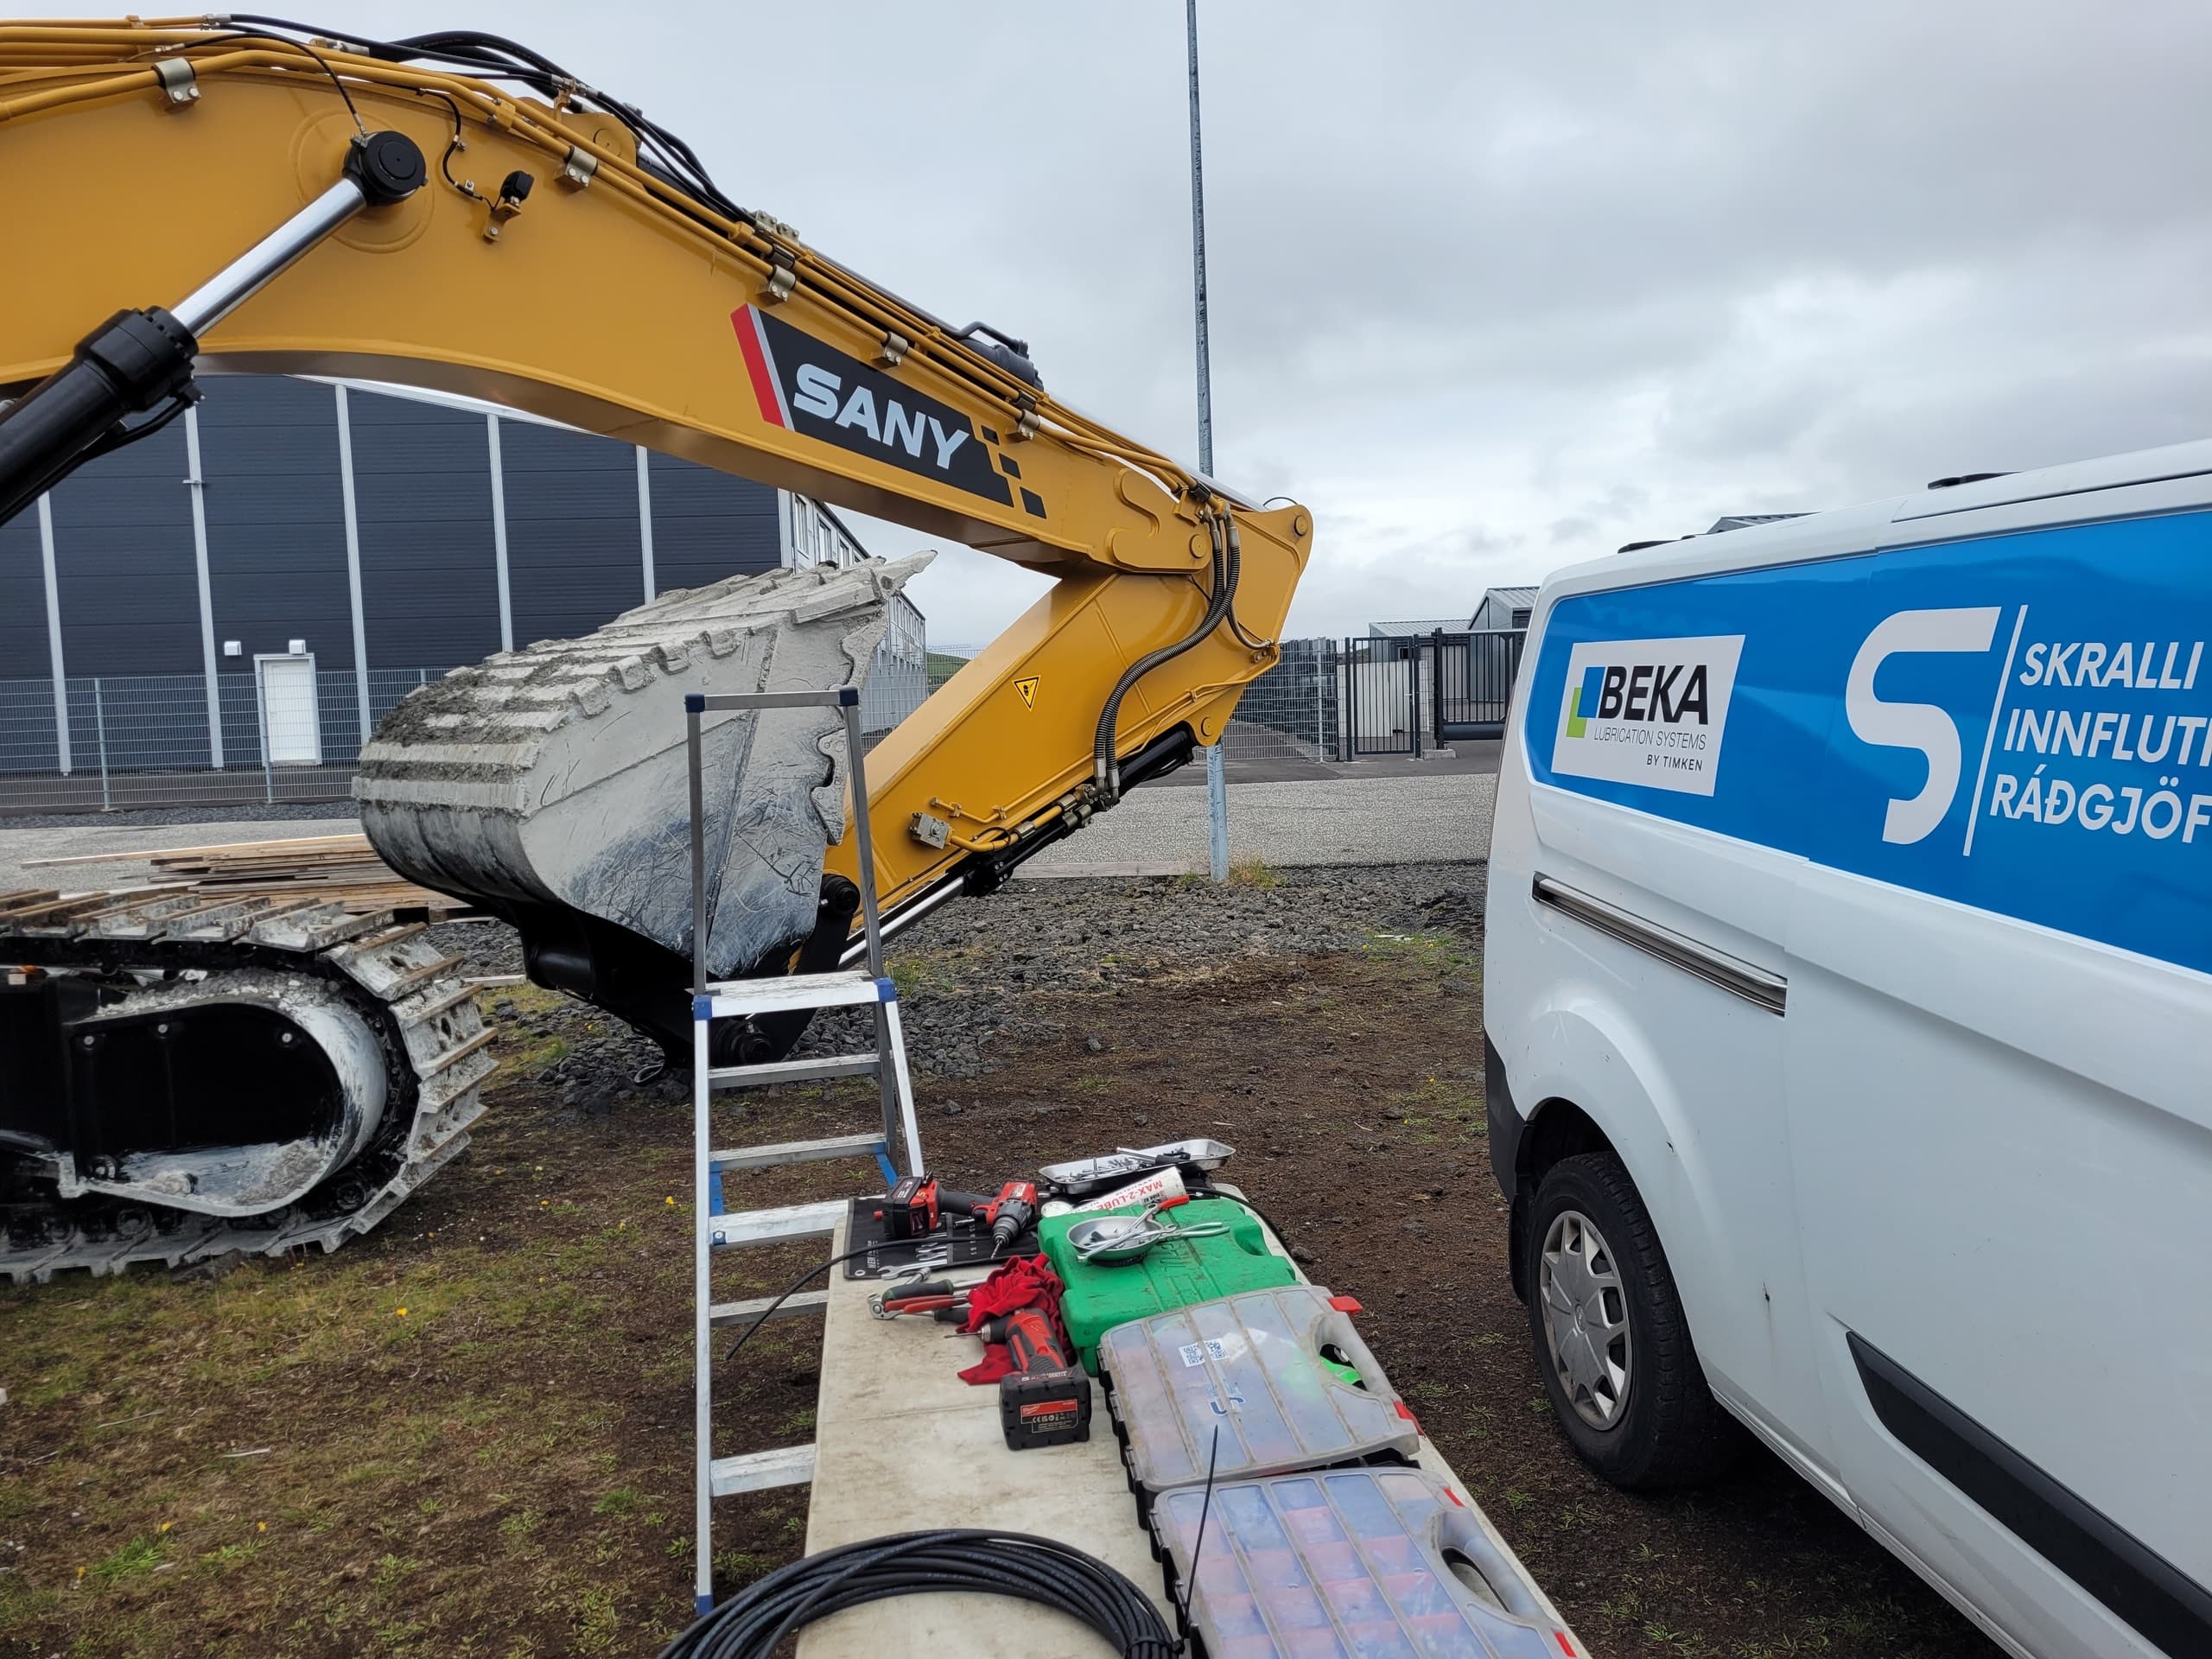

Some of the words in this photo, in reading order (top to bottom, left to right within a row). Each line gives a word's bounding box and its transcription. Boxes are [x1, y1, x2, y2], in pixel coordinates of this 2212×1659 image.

[792, 363, 969, 470] SANY
[2018, 641, 2204, 690] SKRALLI
[1598, 664, 1709, 725] BEKA
[1593, 727, 1654, 746] LUBRICATION
[1656, 731, 1707, 751] SYSTEMS
[1646, 754, 1660, 766] BY
[1663, 756, 1703, 772] TIMKEN
[1989, 764, 2212, 844] RÁÐGJÖF
[1096, 1179, 1164, 1211] MAX-2-LUBE
